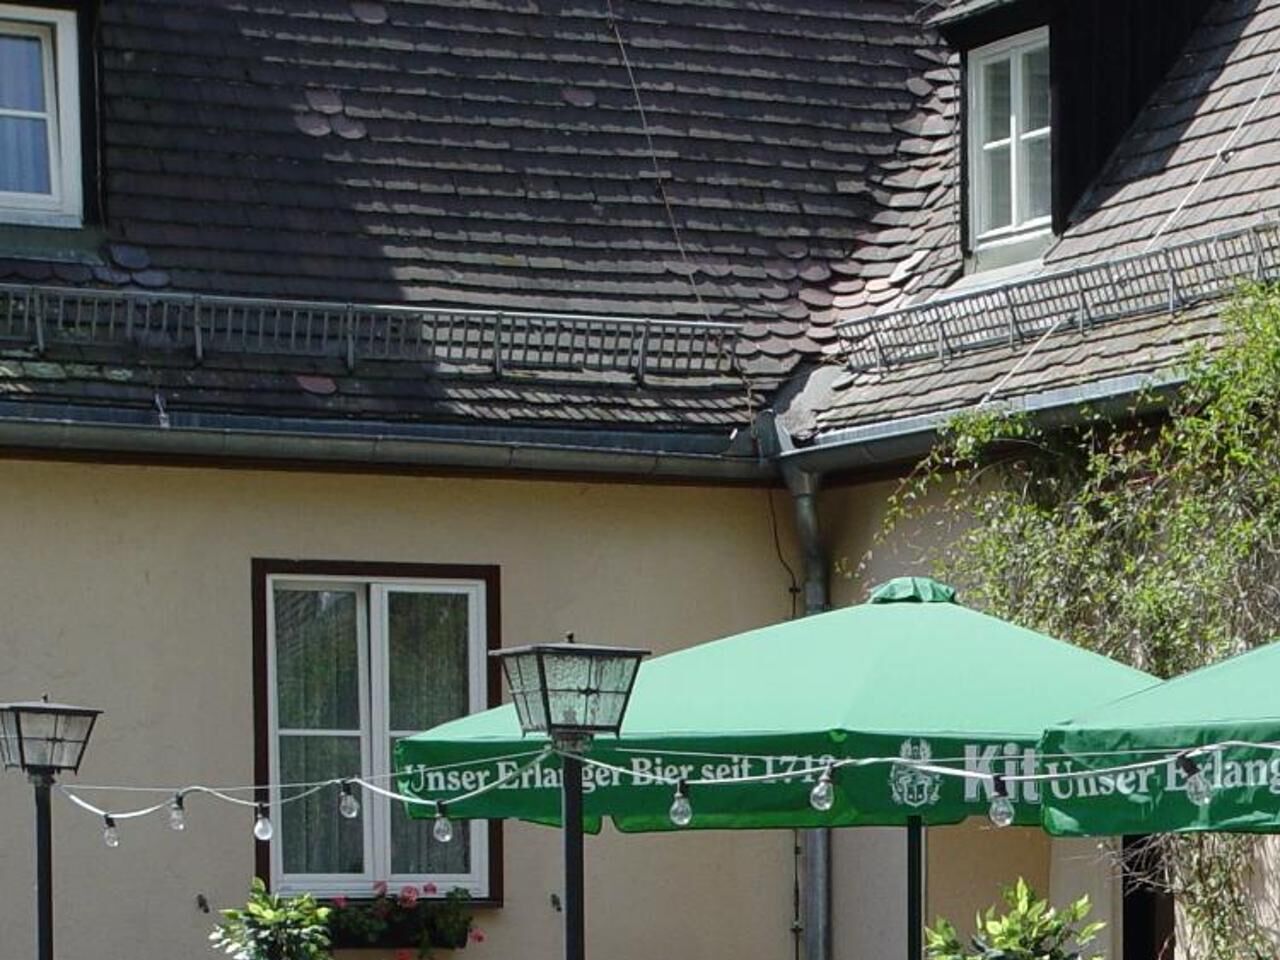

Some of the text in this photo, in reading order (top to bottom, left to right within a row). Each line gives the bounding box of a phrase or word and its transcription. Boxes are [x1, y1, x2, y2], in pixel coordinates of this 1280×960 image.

[403, 763, 490, 793] Unser
[496, 760, 627, 793] Erlager
[631, 757, 694, 786] Bier
[701, 754, 752, 783] seit
[964, 742, 1041, 804] Kit
[1046, 761, 1155, 799] Unser
